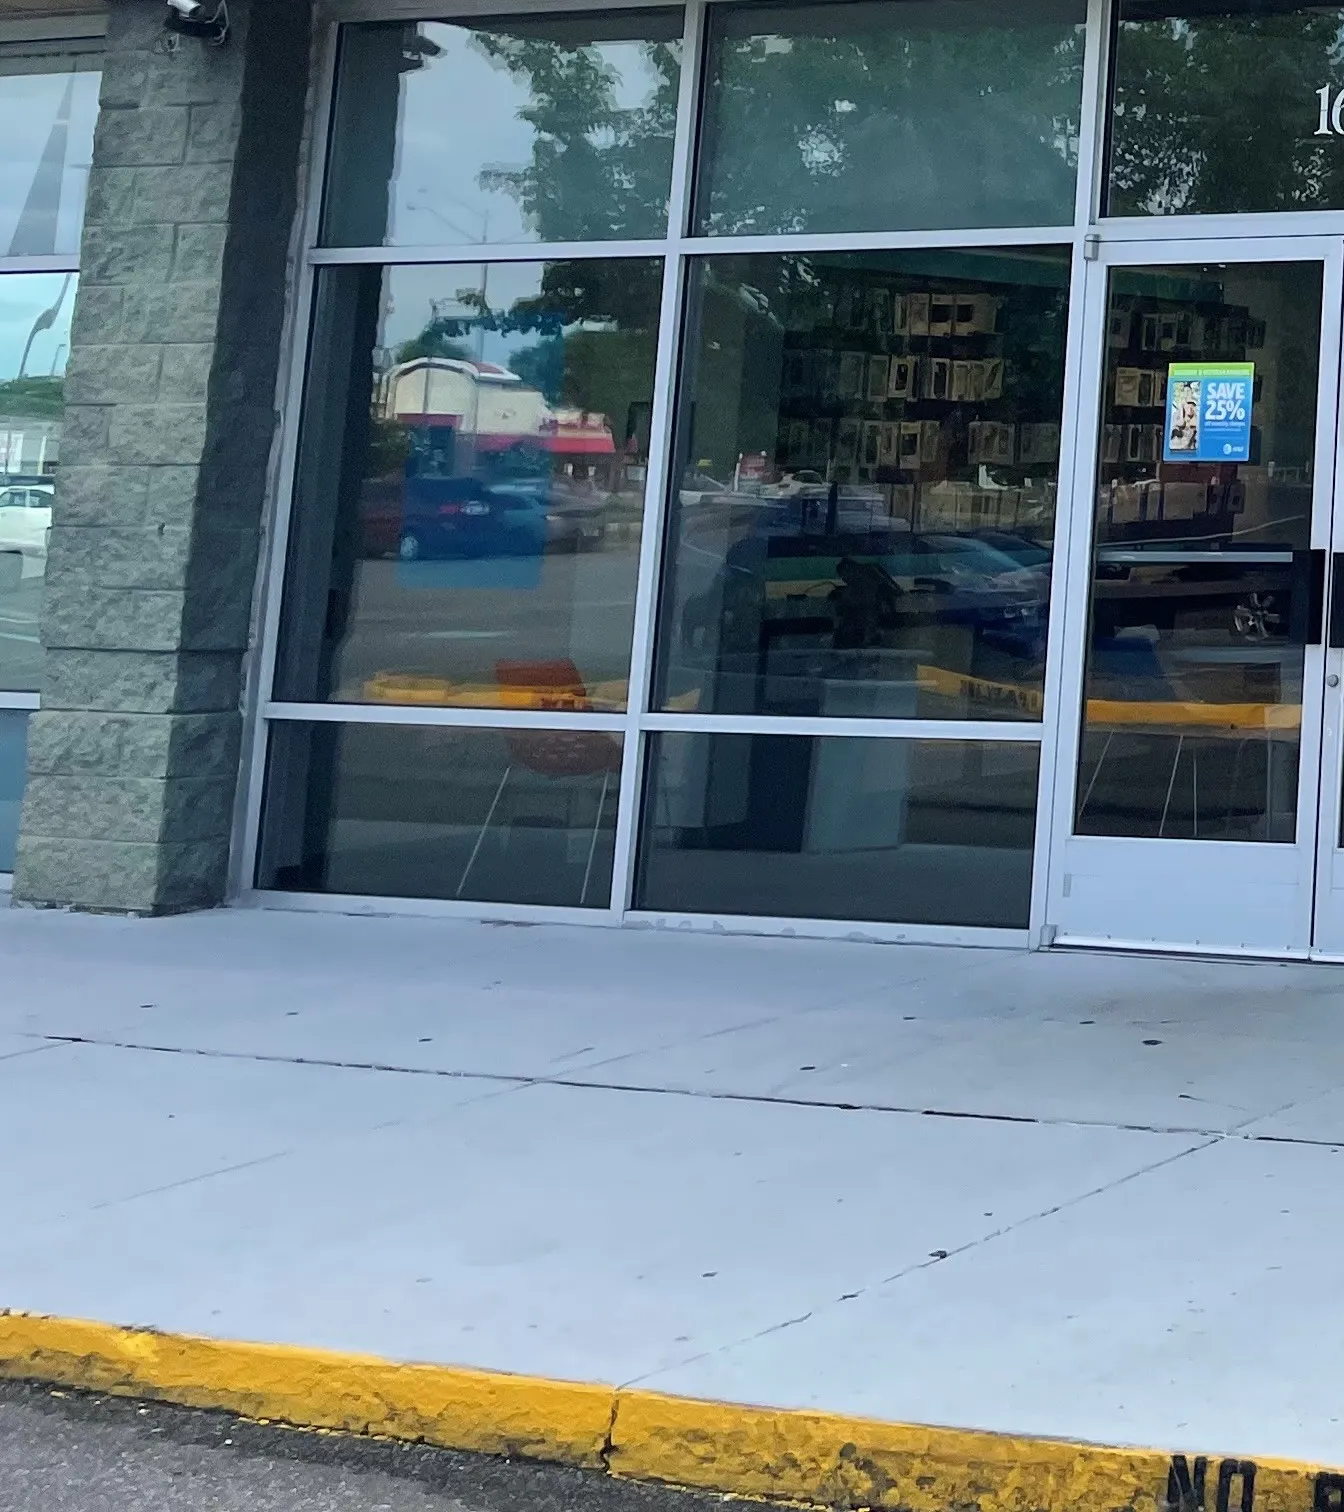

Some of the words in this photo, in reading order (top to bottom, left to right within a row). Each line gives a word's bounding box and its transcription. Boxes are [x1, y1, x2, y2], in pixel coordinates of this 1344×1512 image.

[1207, 382, 1245, 399] SAVE
[1205, 400, 1245, 420] 25%
[1167, 1454, 1257, 1512] NO
